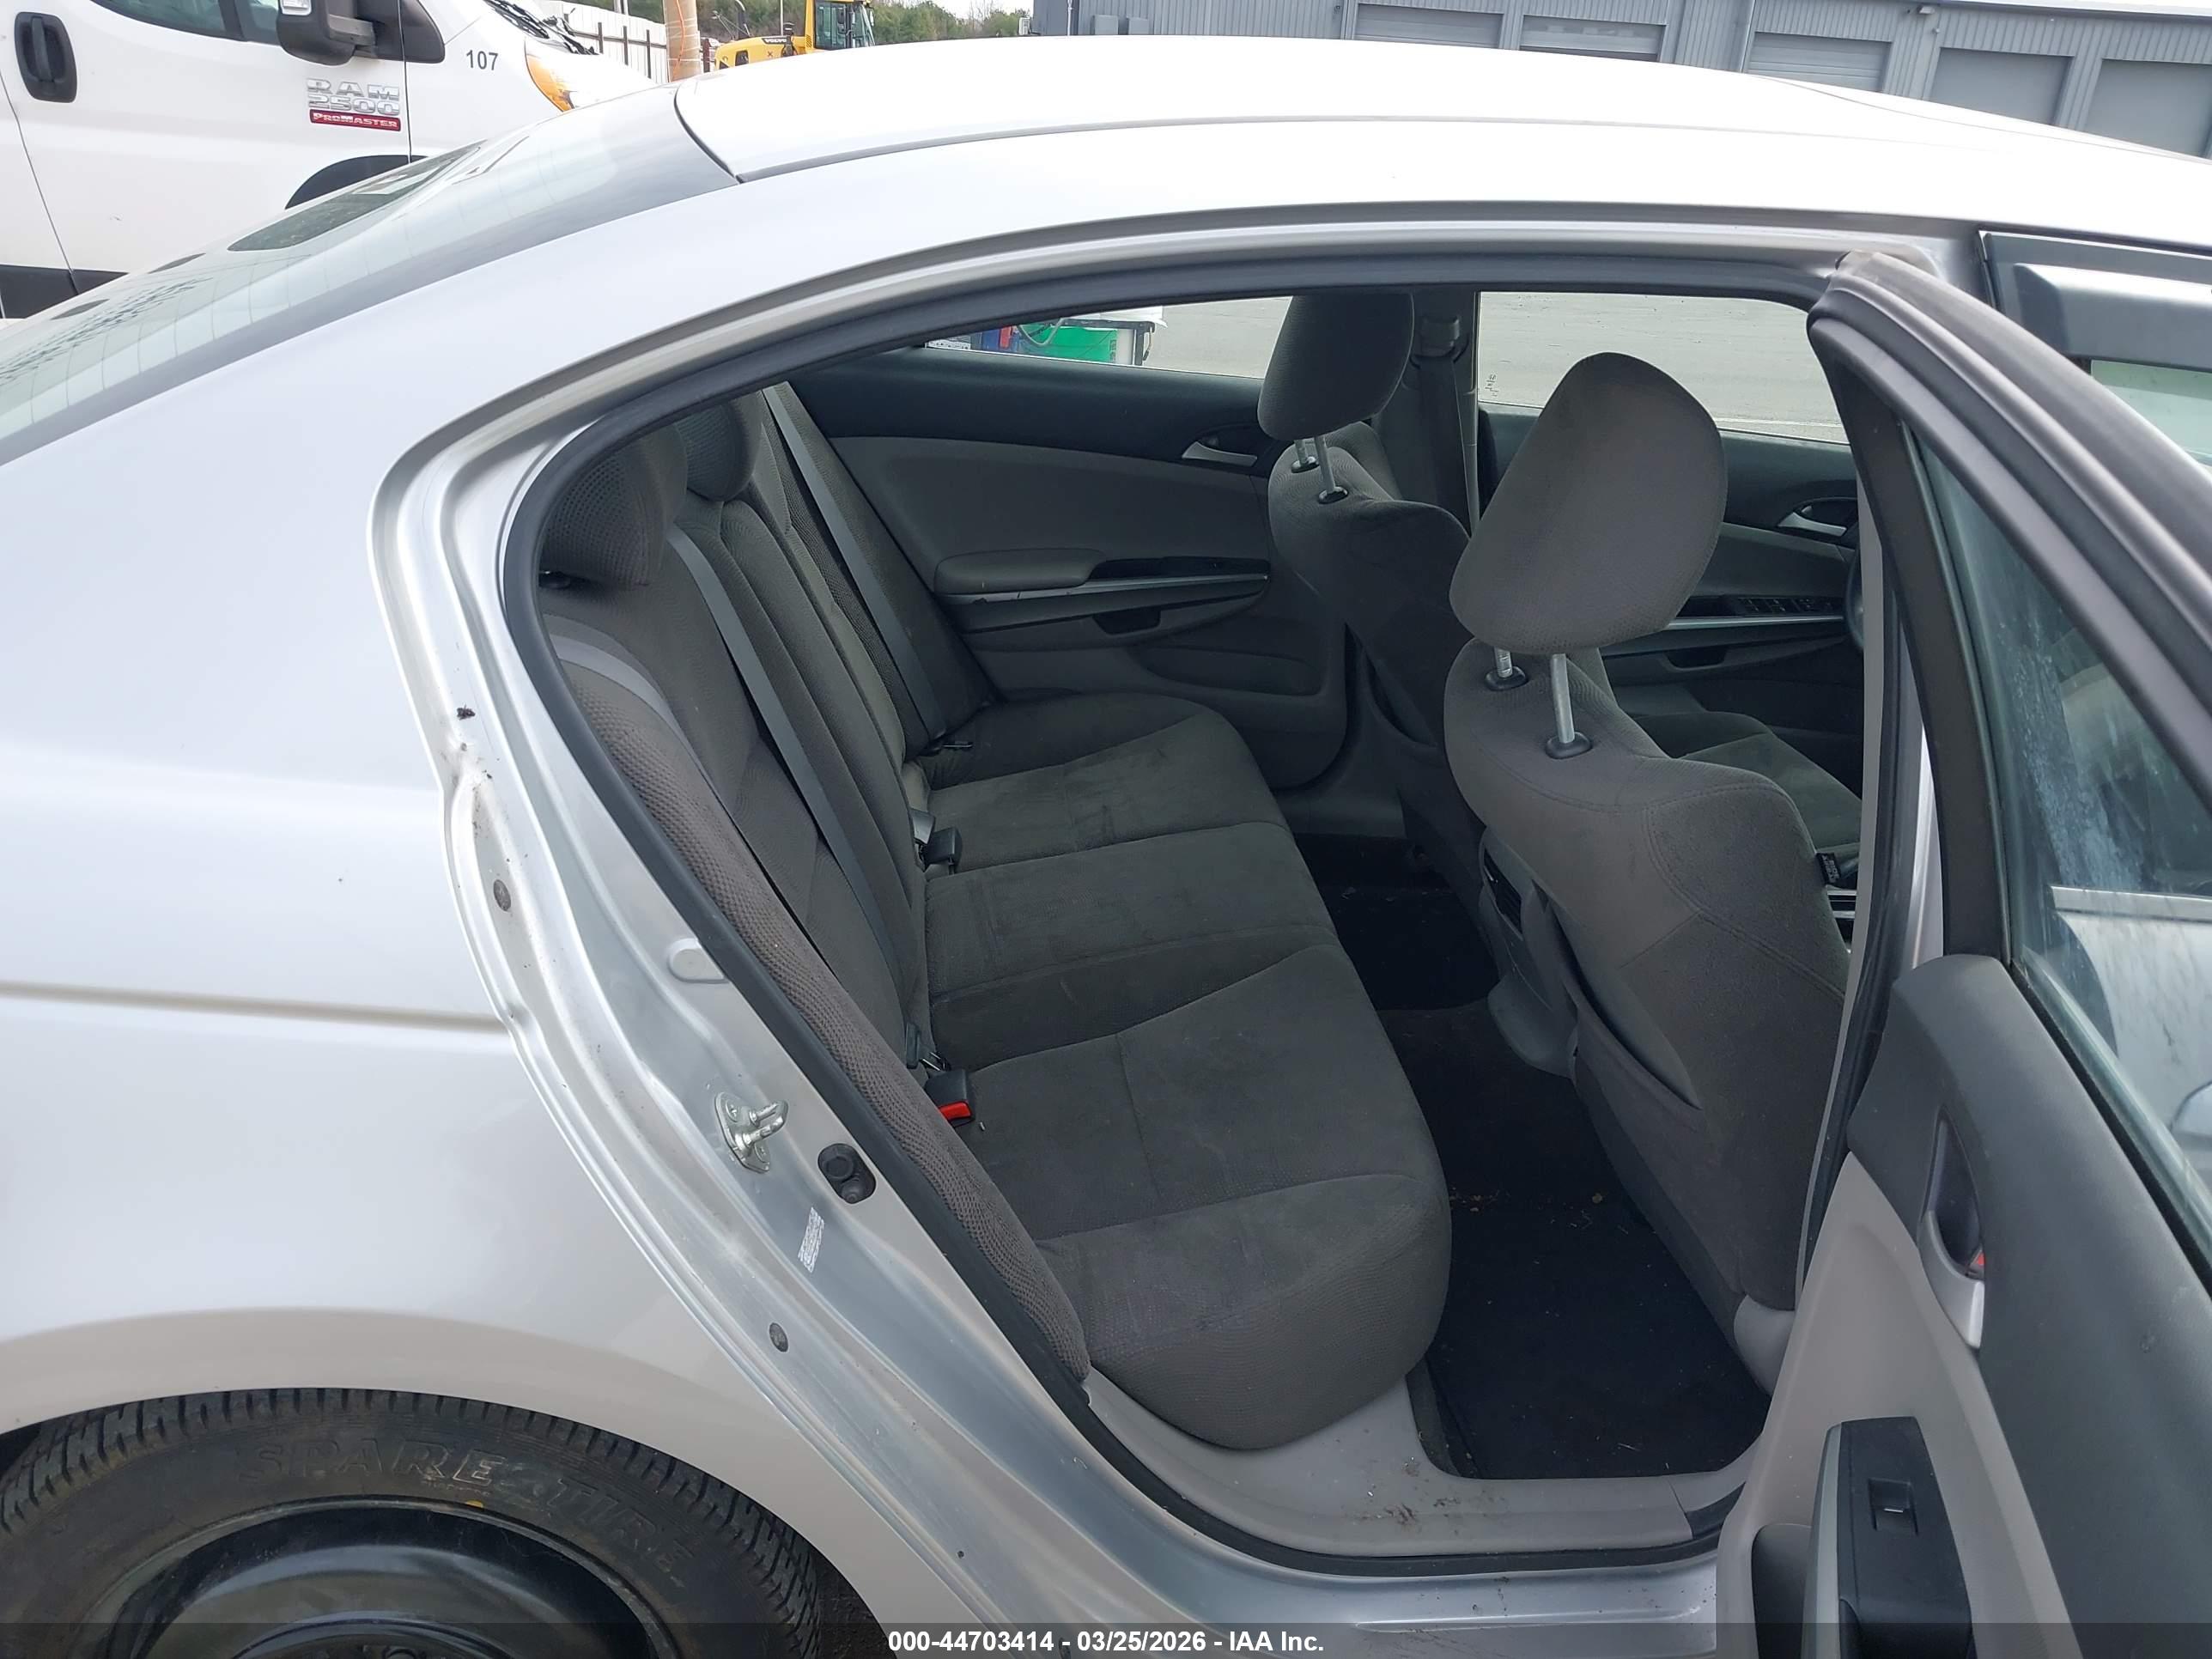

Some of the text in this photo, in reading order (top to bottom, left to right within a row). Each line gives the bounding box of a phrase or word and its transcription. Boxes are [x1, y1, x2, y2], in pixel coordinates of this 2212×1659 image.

[466, 50, 498, 70] 107
[307, 78, 399, 100] RAM
[308, 94, 400, 116] 2500
[239, 1437, 505, 1486] SPARE
